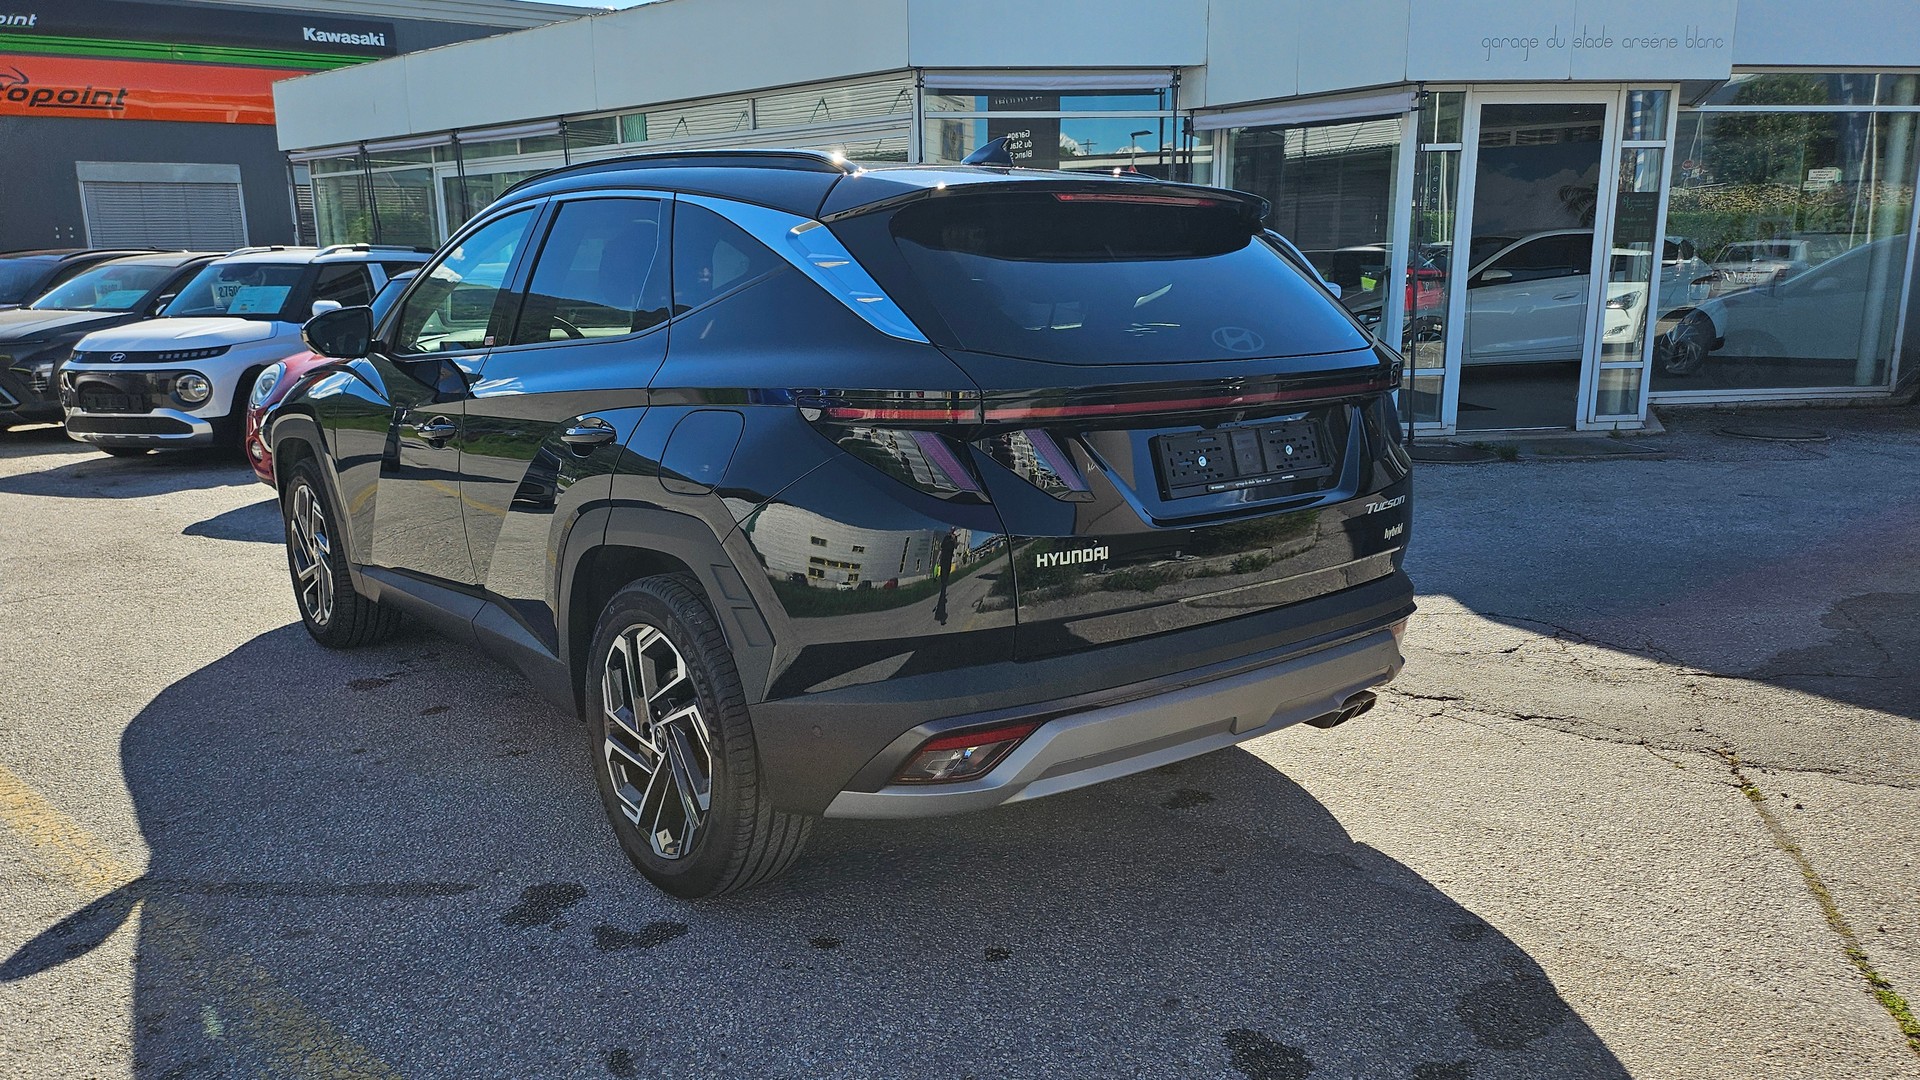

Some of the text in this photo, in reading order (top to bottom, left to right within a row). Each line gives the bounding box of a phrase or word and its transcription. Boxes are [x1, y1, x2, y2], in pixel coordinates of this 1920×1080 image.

[303, 27, 385, 46] Kawasaki
[1481, 37, 1539, 61] garage
[1546, 24, 1566, 48] du
[1572, 24, 1613, 48] stade
[1685, 24, 1724, 48] blanc
[1384, 522, 1404, 541] hybrid
[1036, 546, 1109, 568] HYUNDAI
